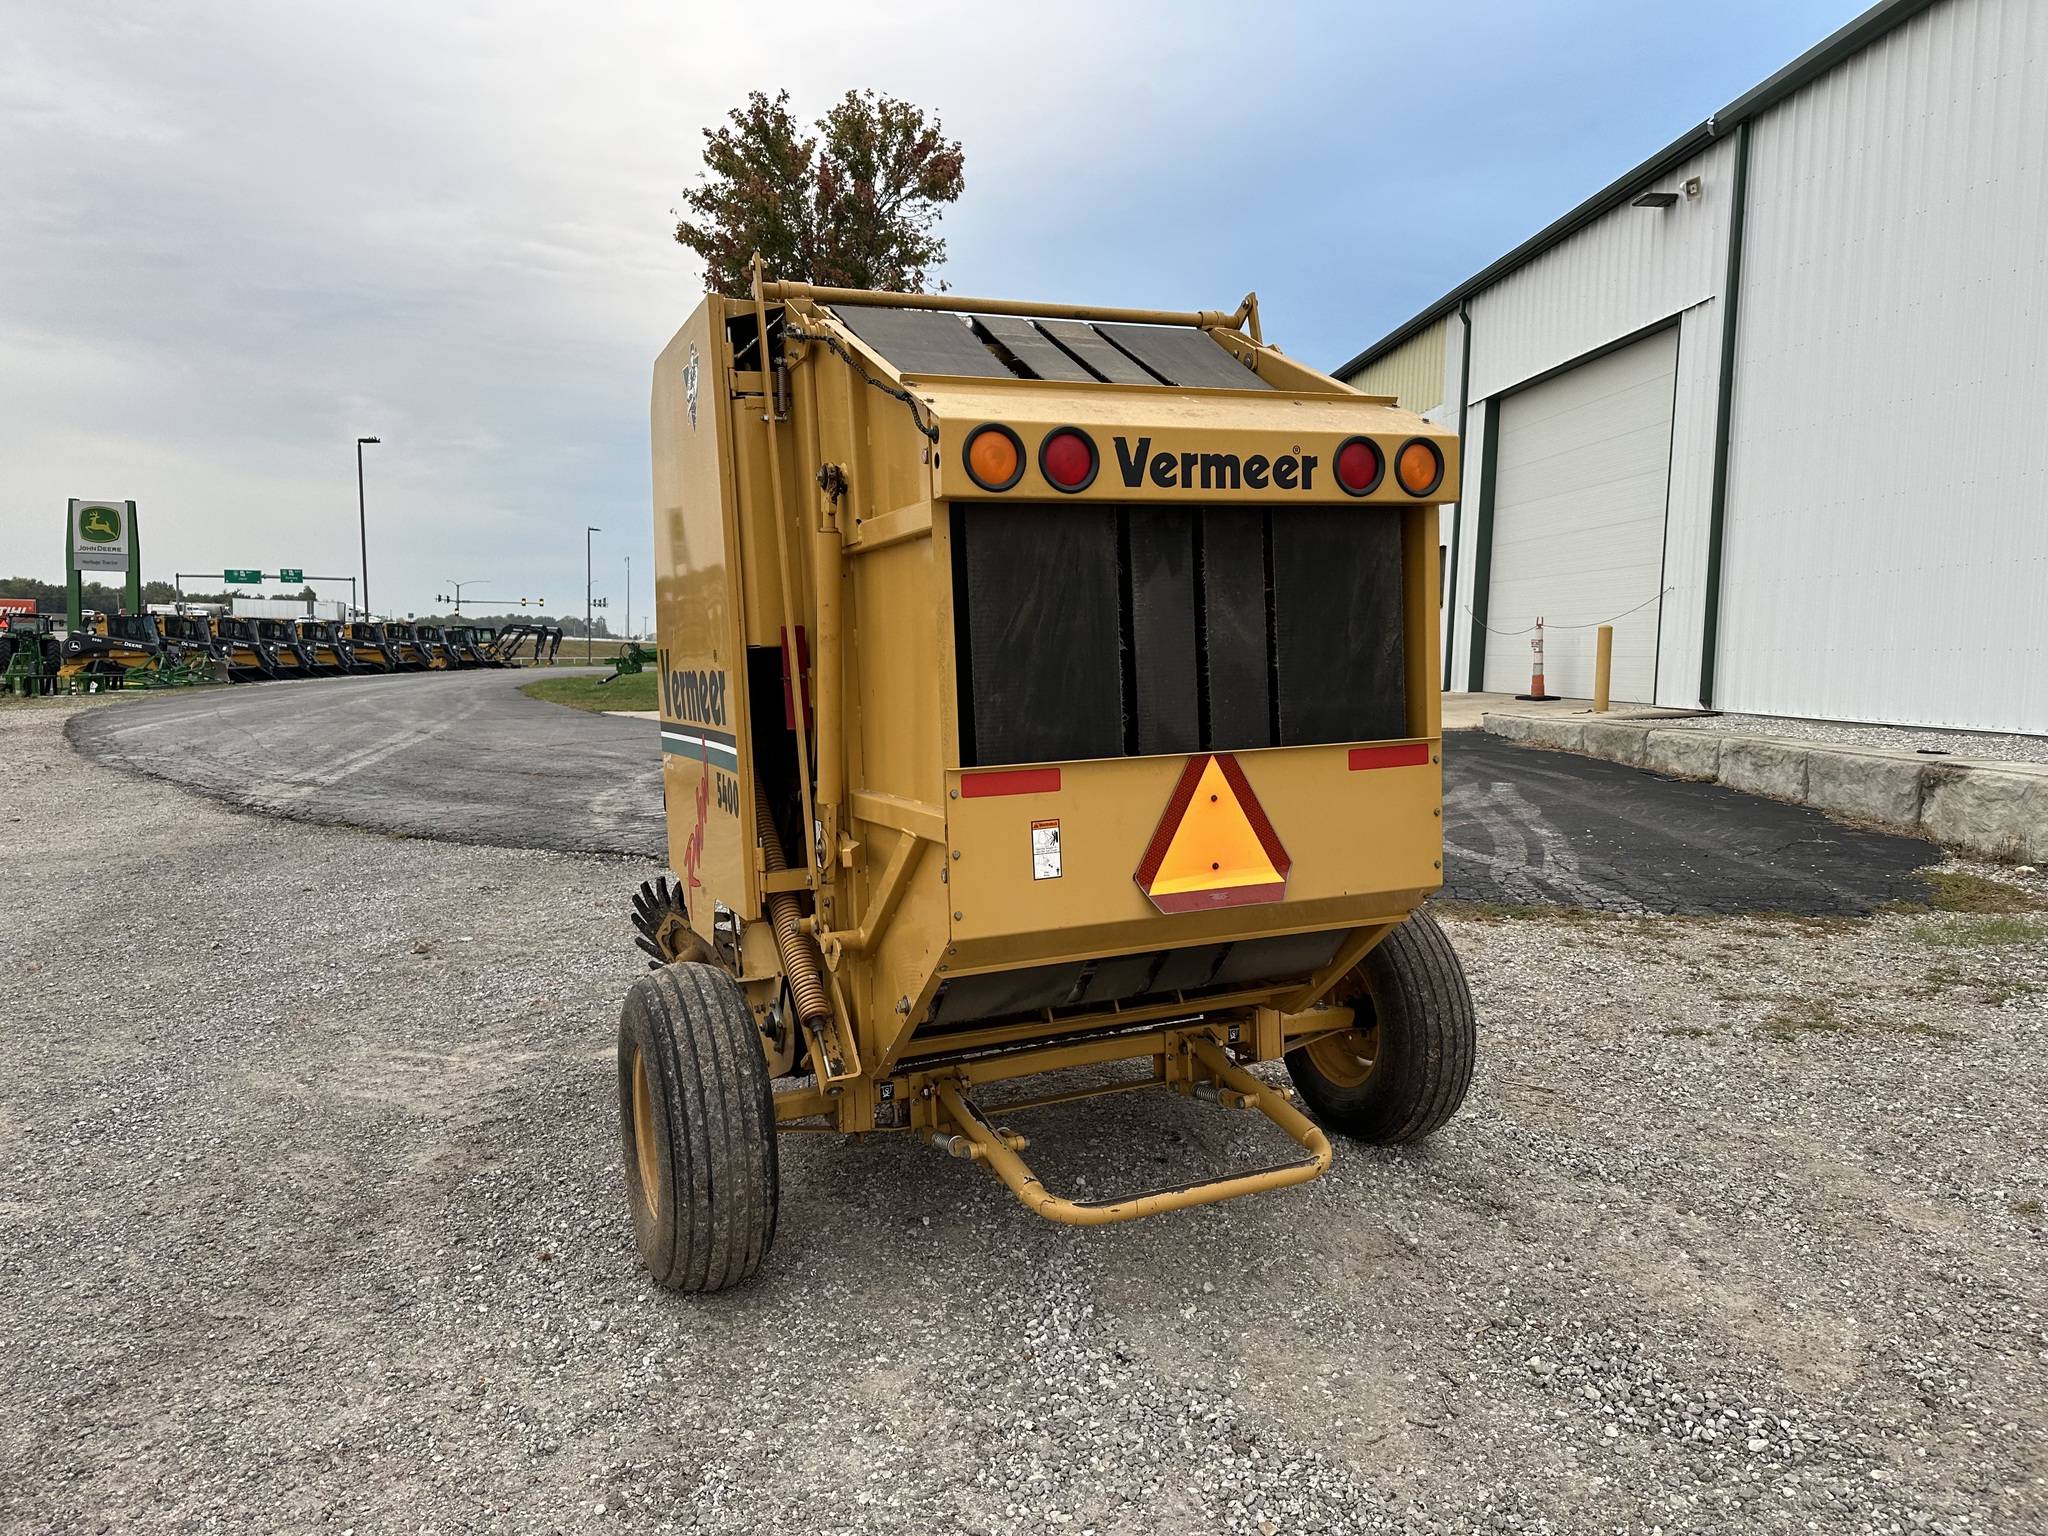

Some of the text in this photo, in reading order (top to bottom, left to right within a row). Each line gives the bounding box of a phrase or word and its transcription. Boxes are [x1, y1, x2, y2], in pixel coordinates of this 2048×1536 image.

[1112, 436, 1318, 490] Vermeer
[660, 649, 726, 726] Vermeer
[716, 771, 739, 819] 5400
